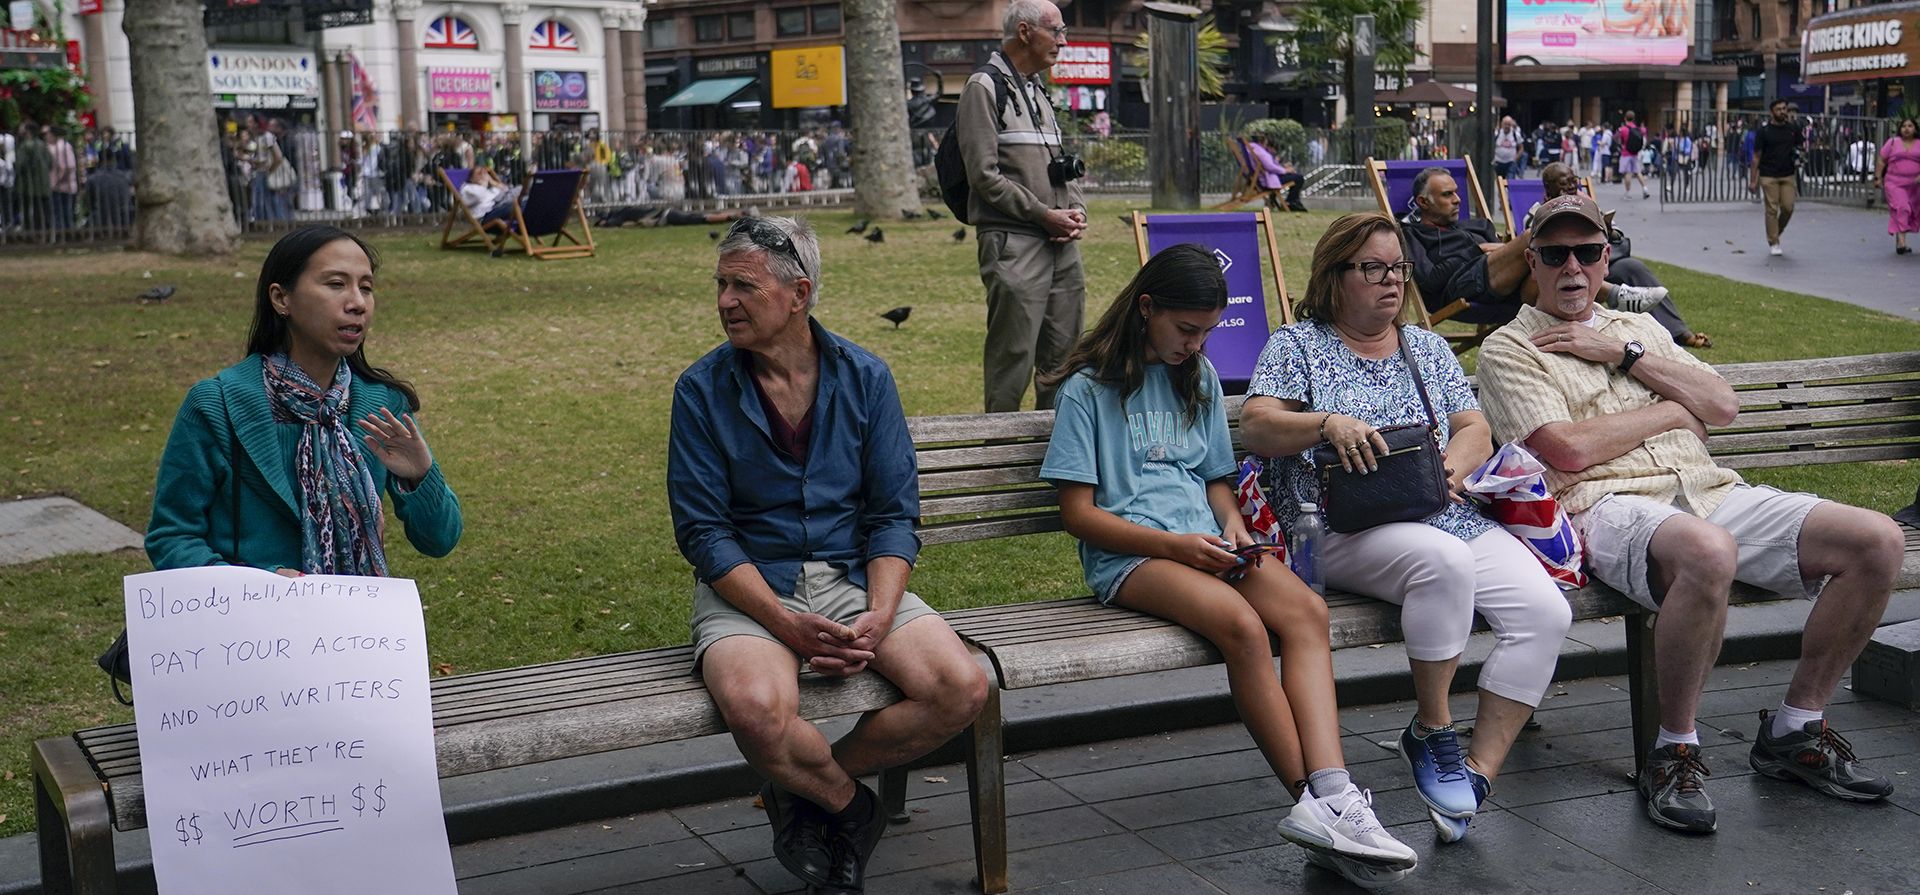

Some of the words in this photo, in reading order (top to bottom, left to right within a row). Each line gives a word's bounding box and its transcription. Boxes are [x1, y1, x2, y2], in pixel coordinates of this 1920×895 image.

[1809, 25, 1853, 54] BURGER
[1853, 19, 1903, 48] KING
[223, 57, 297, 71] LONDON
[1851, 55, 1880, 71] SINCE
[1880, 52, 1908, 69] 1954
[213, 75, 313, 90] SOUVENIRS
[434, 77, 452, 94] ICE
[453, 77, 490, 94] CREAM
[236, 94, 262, 109] VAPE
[262, 94, 289, 109] SHOP
[1226, 296, 1253, 307] uare
[139, 587, 230, 618] Bloody
[242, 583, 281, 602] hell,
[151, 648, 205, 675] PAY
[220, 638, 290, 666] YOUR
[311, 635, 407, 656] ACTORS
[160, 709, 198, 731] AND
[207, 695, 268, 719] YOUR
[281, 679, 403, 708] WRITERS
[190, 754, 253, 781] WHAT
[264, 740, 365, 766] THEY'RE
[175, 812, 204, 847] $$
[224, 794, 338, 831] WORTH
[351, 779, 387, 818] $$
